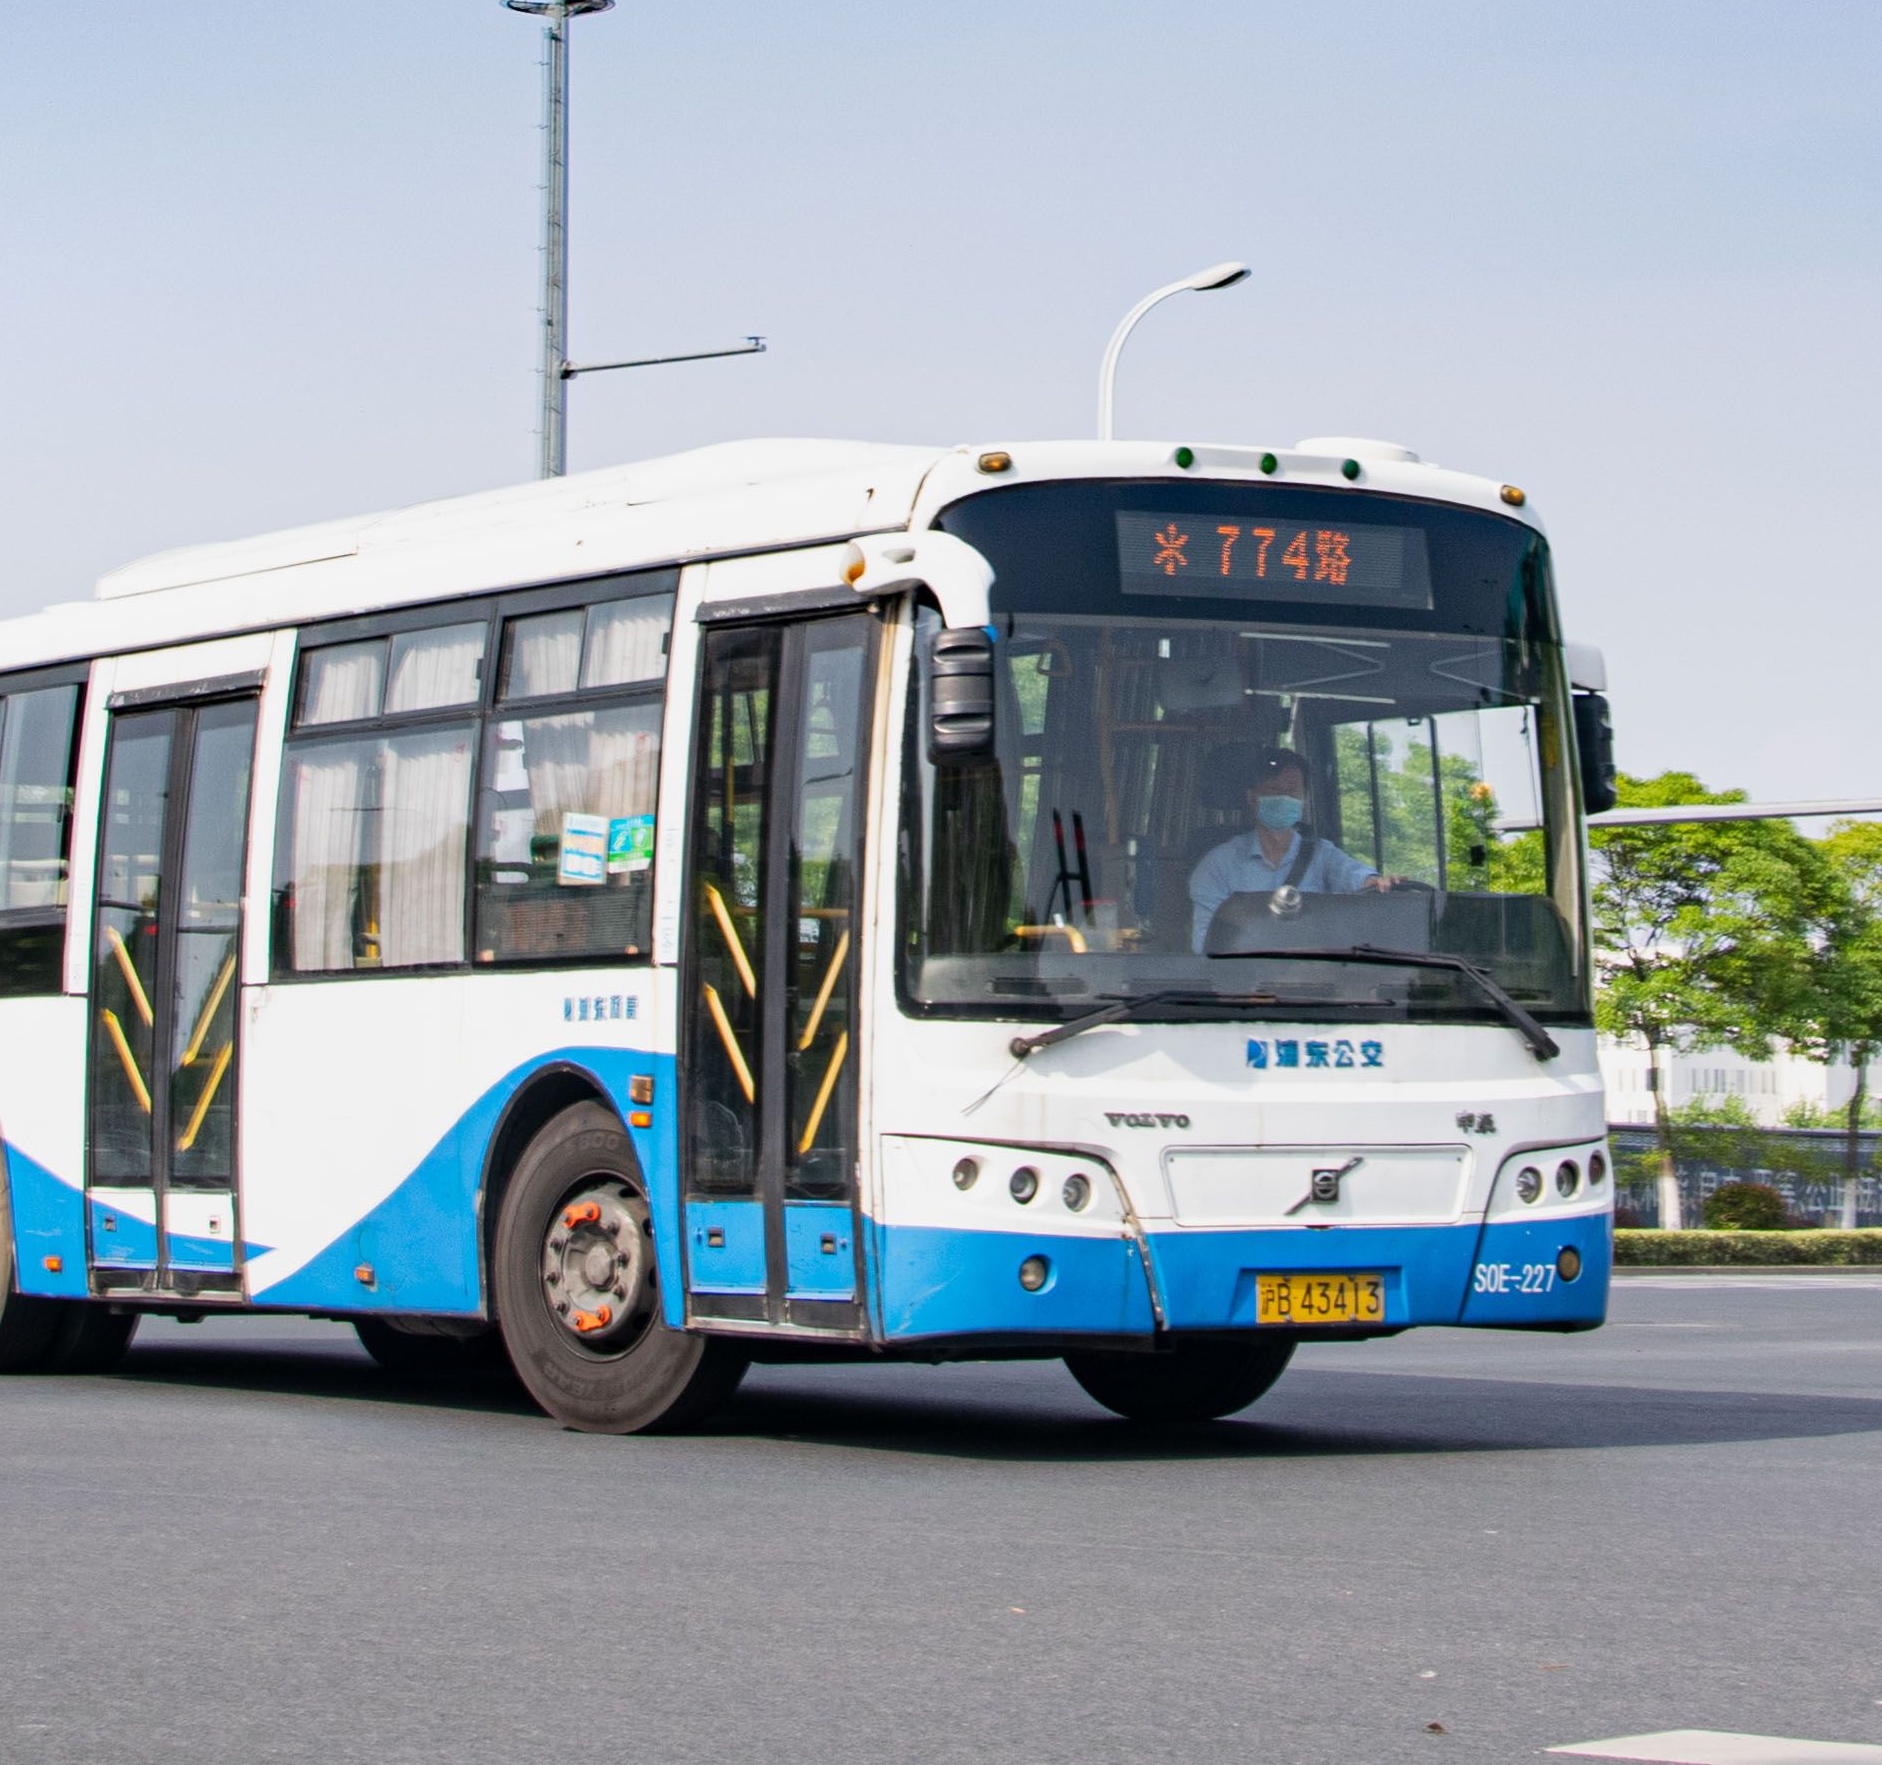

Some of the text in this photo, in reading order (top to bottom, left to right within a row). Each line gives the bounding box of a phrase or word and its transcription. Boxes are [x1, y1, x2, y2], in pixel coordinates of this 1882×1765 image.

[1274, 1039, 1384, 1068] 浦东公交
[1103, 1112, 1191, 1129] VOLVO
